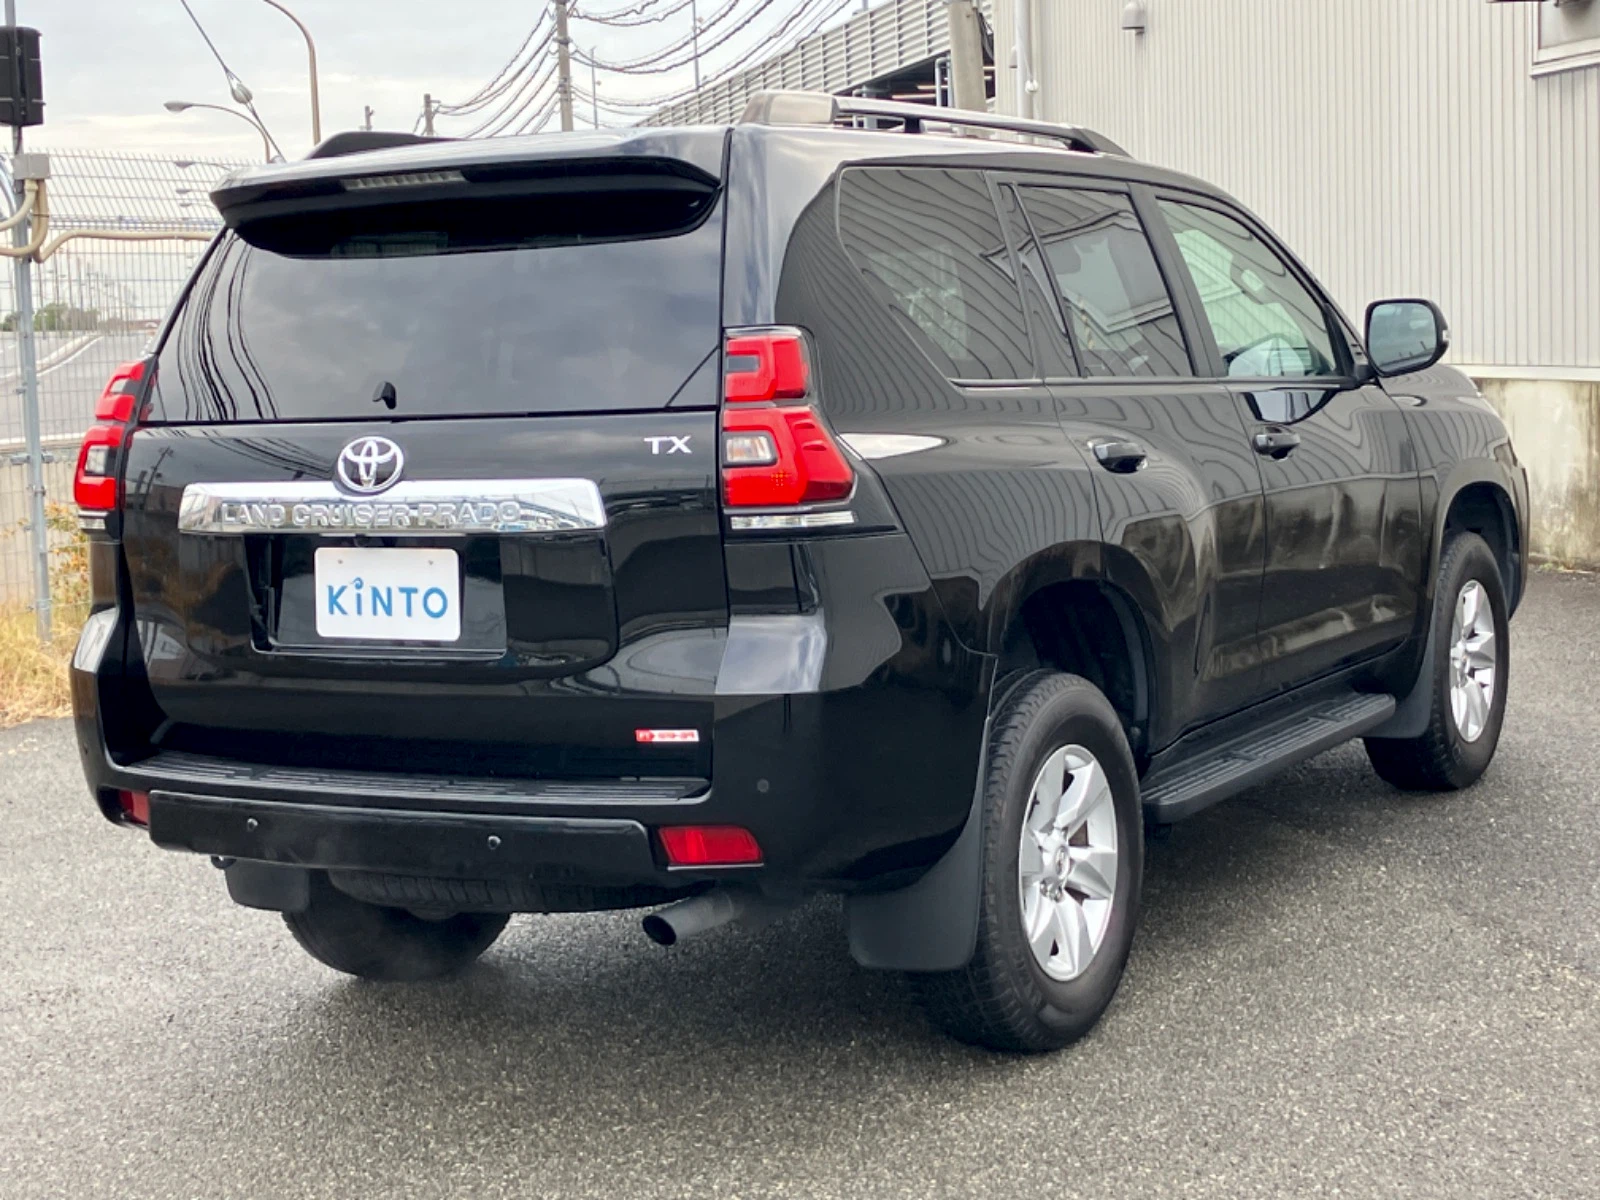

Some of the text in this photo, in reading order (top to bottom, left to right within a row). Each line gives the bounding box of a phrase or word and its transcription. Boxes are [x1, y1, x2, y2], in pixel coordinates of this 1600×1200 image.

[643, 435, 692, 455] TX
[220, 501, 522, 527] LAND CRUISER PRADO
